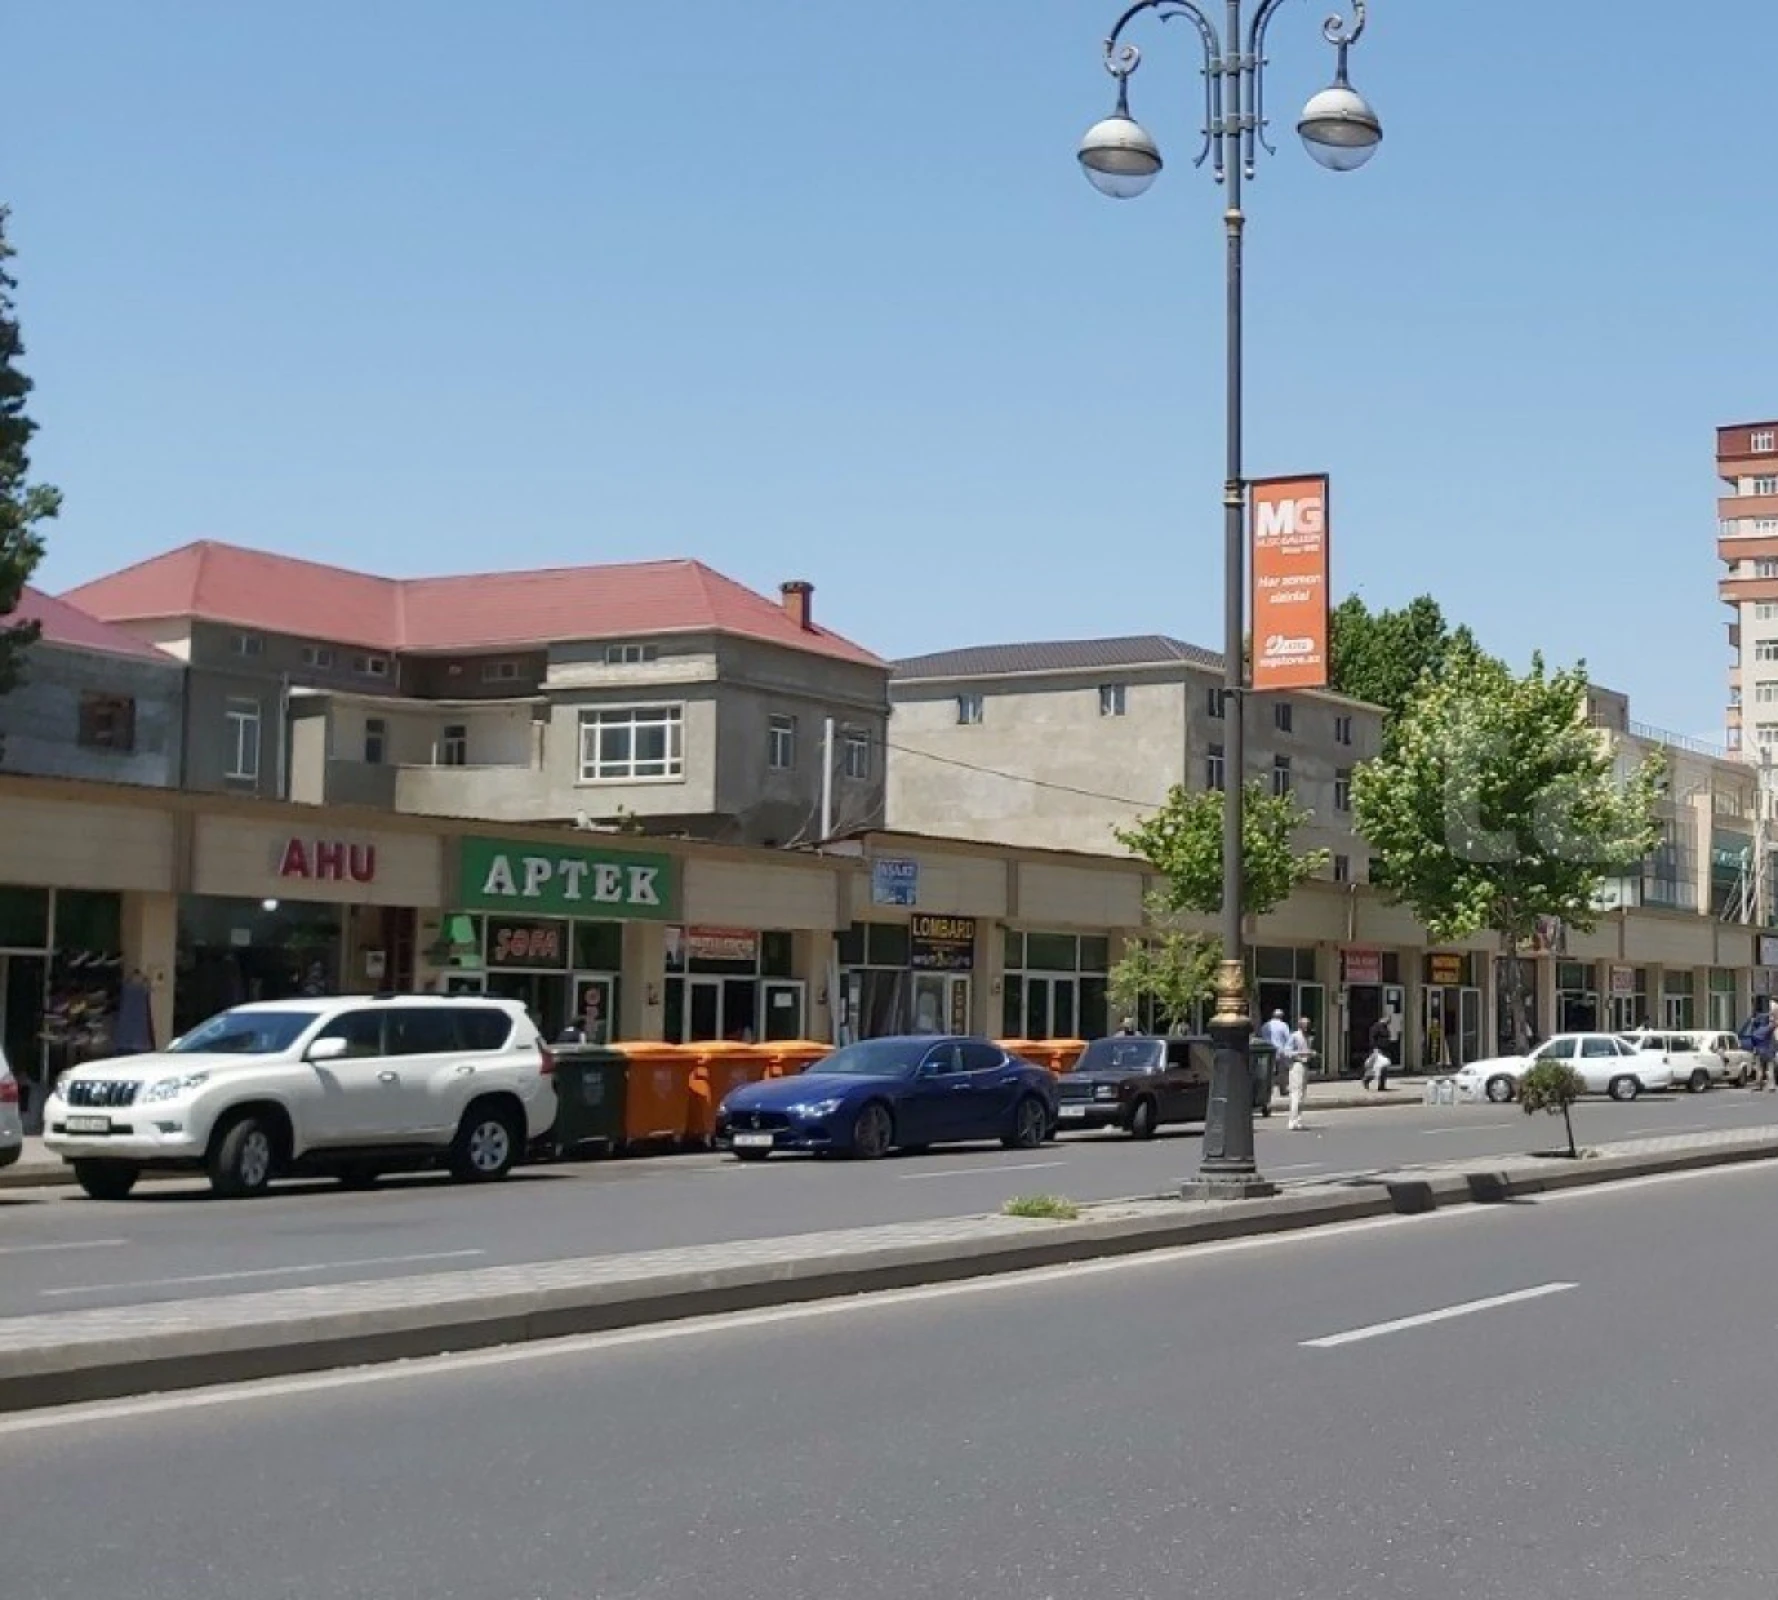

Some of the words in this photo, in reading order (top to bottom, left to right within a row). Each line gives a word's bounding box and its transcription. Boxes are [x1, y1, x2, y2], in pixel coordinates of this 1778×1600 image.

[1257, 497, 1321, 536] MG
[280, 836, 376, 883] AHU
[482, 854, 661, 905] APTEK
[912, 916, 975, 939] LOMBARD
